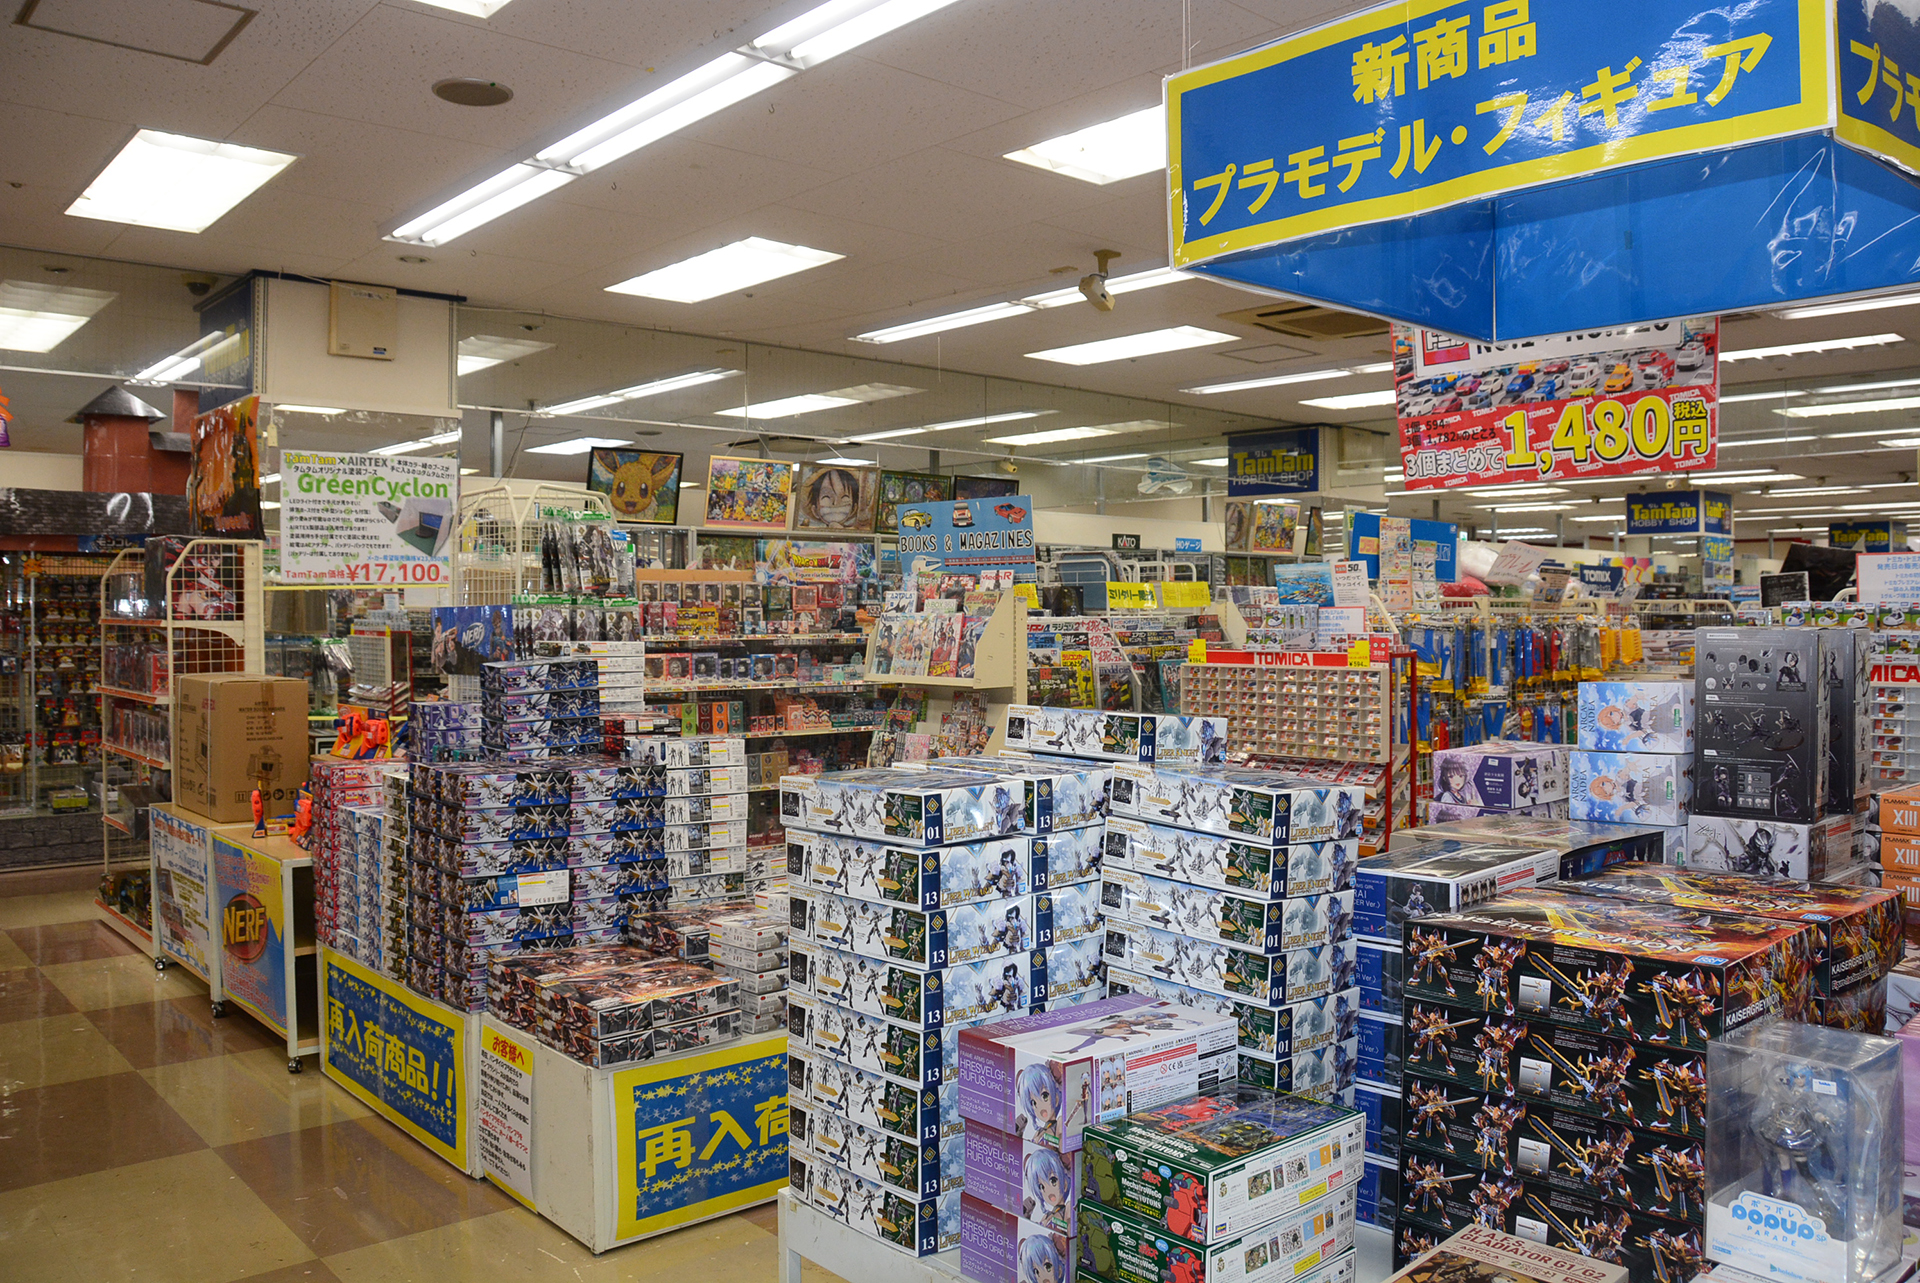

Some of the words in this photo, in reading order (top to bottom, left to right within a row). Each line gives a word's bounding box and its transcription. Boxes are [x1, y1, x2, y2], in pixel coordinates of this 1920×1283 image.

[1352, 0, 1537, 104] 新商品
[1194, 32, 1773, 226] プラモデル・フィギュア
[1505, 395, 1671, 476] 1,480
[284, 453, 336, 465] TamTam
[1233, 449, 1314, 476] TamTam
[1405, 447, 1503, 478] 3個まとめて
[1281, 470, 1314, 482] SHOP
[297, 473, 448, 501] GreenCyclon
[1631, 503, 1697, 520] TamTam
[1631, 519, 1663, 527] HOBBY
[1669, 517, 1697, 526] SHOP
[900, 534, 937, 552] BOOKS
[944, 533, 953, 552] &
[960, 529, 1034, 551] MAGAZINES
[1117, 536, 1136, 547] KATO
[1583, 569, 1612, 582] TOMIX
[1256, 652, 1311, 666] TOMICA
[1141, 744, 1153, 757] 01
[1040, 815, 1051, 829] 13
[1893, 809, 1918, 827] XIII
[927, 825, 940, 839] 01
[1275, 825, 1287, 840] 01
[1894, 848, 1919, 866] XIII
[1034, 872, 1046, 886] 13
[1273, 879, 1285, 893] 01
[925, 891, 938, 905] 13
[223, 905, 267, 945] NERF
[1038, 929, 1051, 943] 13
[1267, 934, 1279, 948] 01
[932, 950, 945, 963] 13
[1831, 949, 1876, 976] KAISERGREYMON
[1033, 985, 1045, 998] 13
[1271, 986, 1283, 1000] 01
[927, 1009, 941, 1024] 13
[1725, 991, 1781, 1028] KAISERGREYMON
[492, 1035, 525, 1066] お客様へ
[1277, 1039, 1289, 1053] 01
[926, 1068, 940, 1082] 13
[960, 1070, 986, 1089] RUFUS
[923, 1125, 937, 1139] 13
[966, 1149, 993, 1168] RUFUS
[924, 1179, 938, 1194] 13
[1121, 1177, 1163, 1200] MechatroWeGo
[1139, 1194, 1162, 1210] VOTOMS
[1731, 1204, 1815, 1240] POPUP
[921, 1236, 936, 1251] 13
[961, 1230, 989, 1250] RUFUS
[1747, 1225, 1798, 1247] PARADE
[1459, 1232, 1555, 1265] GLADIATOR
[1117, 1249, 1159, 1273] MechatroWeGo
